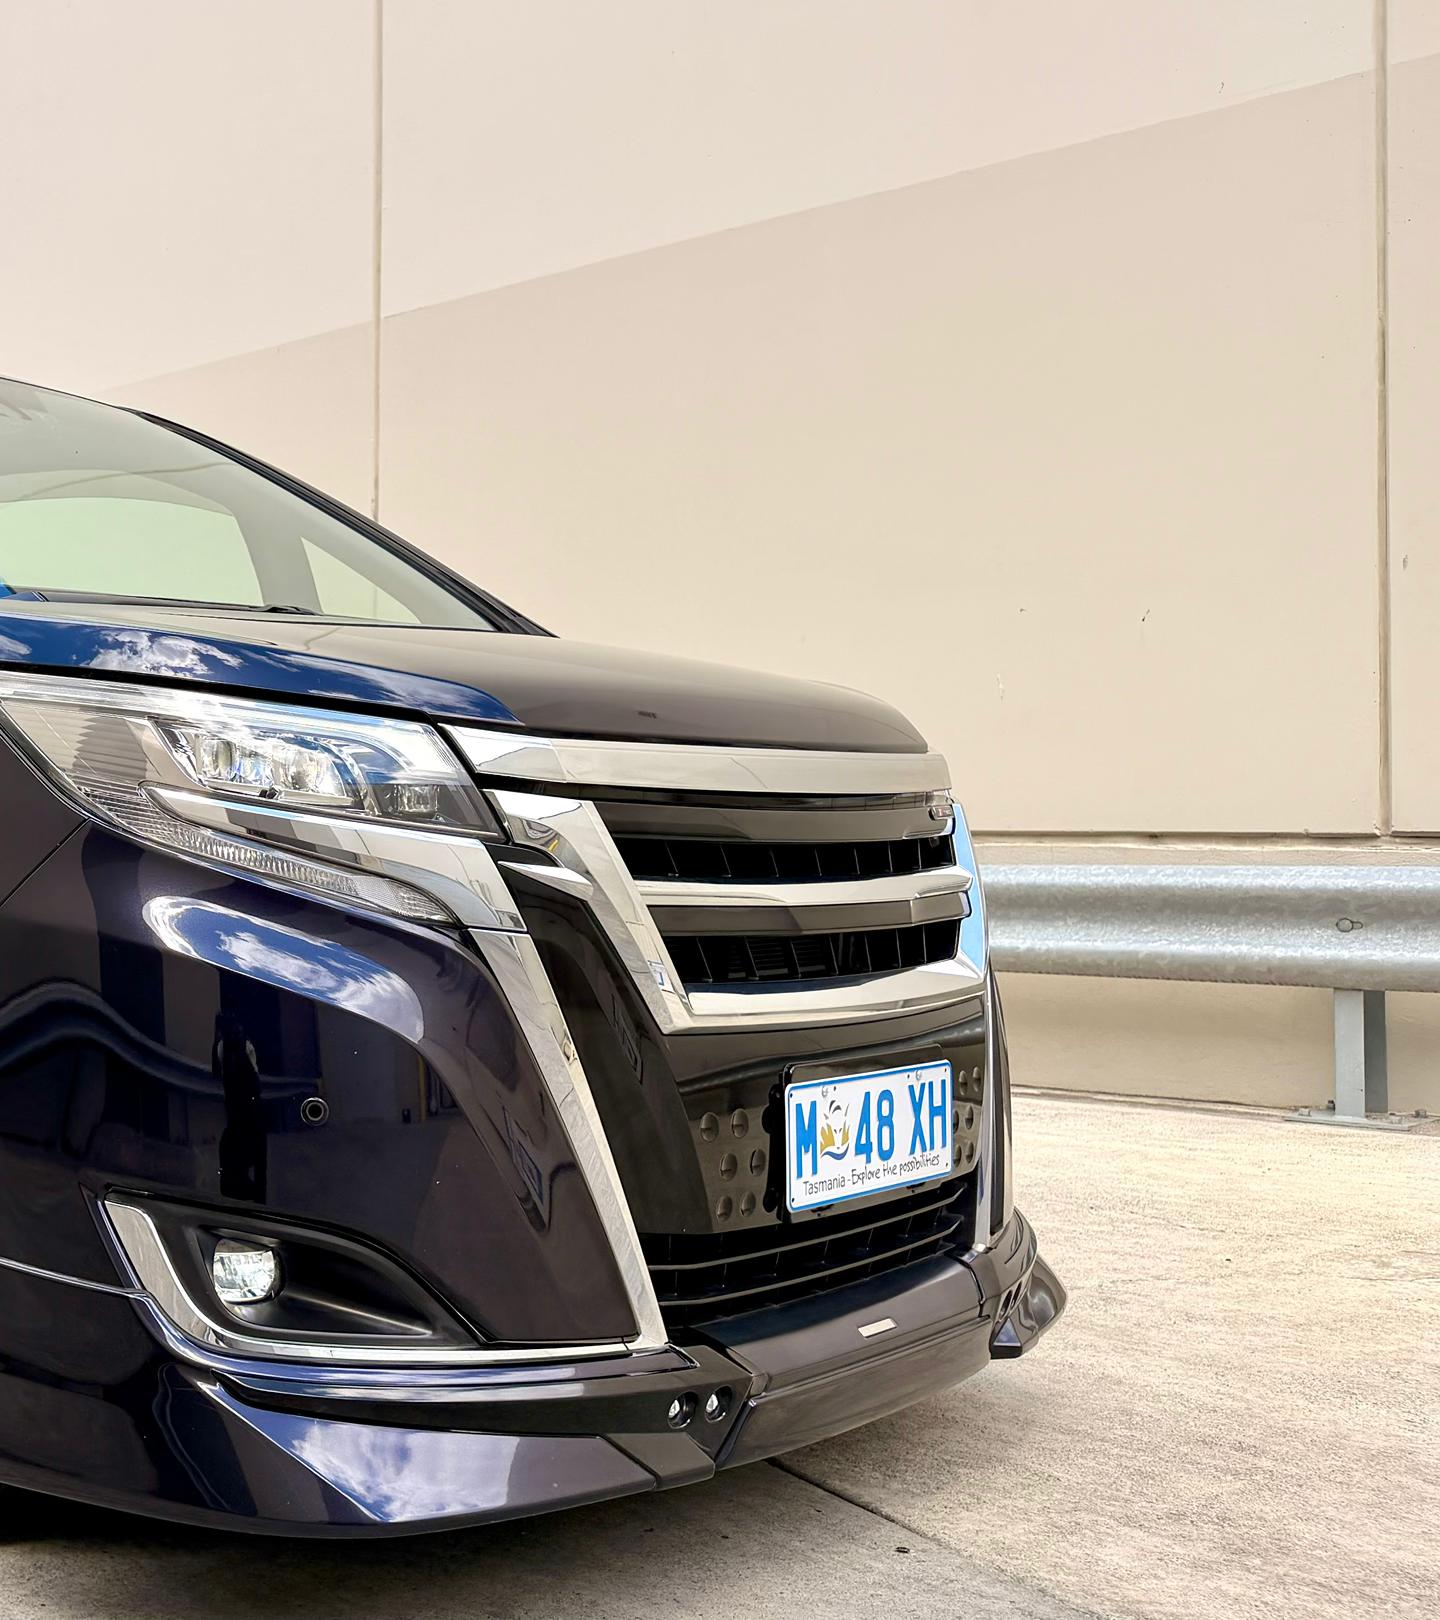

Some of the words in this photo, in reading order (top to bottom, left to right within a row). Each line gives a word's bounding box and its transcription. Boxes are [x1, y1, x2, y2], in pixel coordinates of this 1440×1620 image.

[854, 1089, 895, 1164] 48
[908, 1079, 947, 1156] XH
[803, 1174, 846, 1196] Tasmania
[882, 1160, 898, 1177] the
[899, 1152, 940, 1177] possibilities
